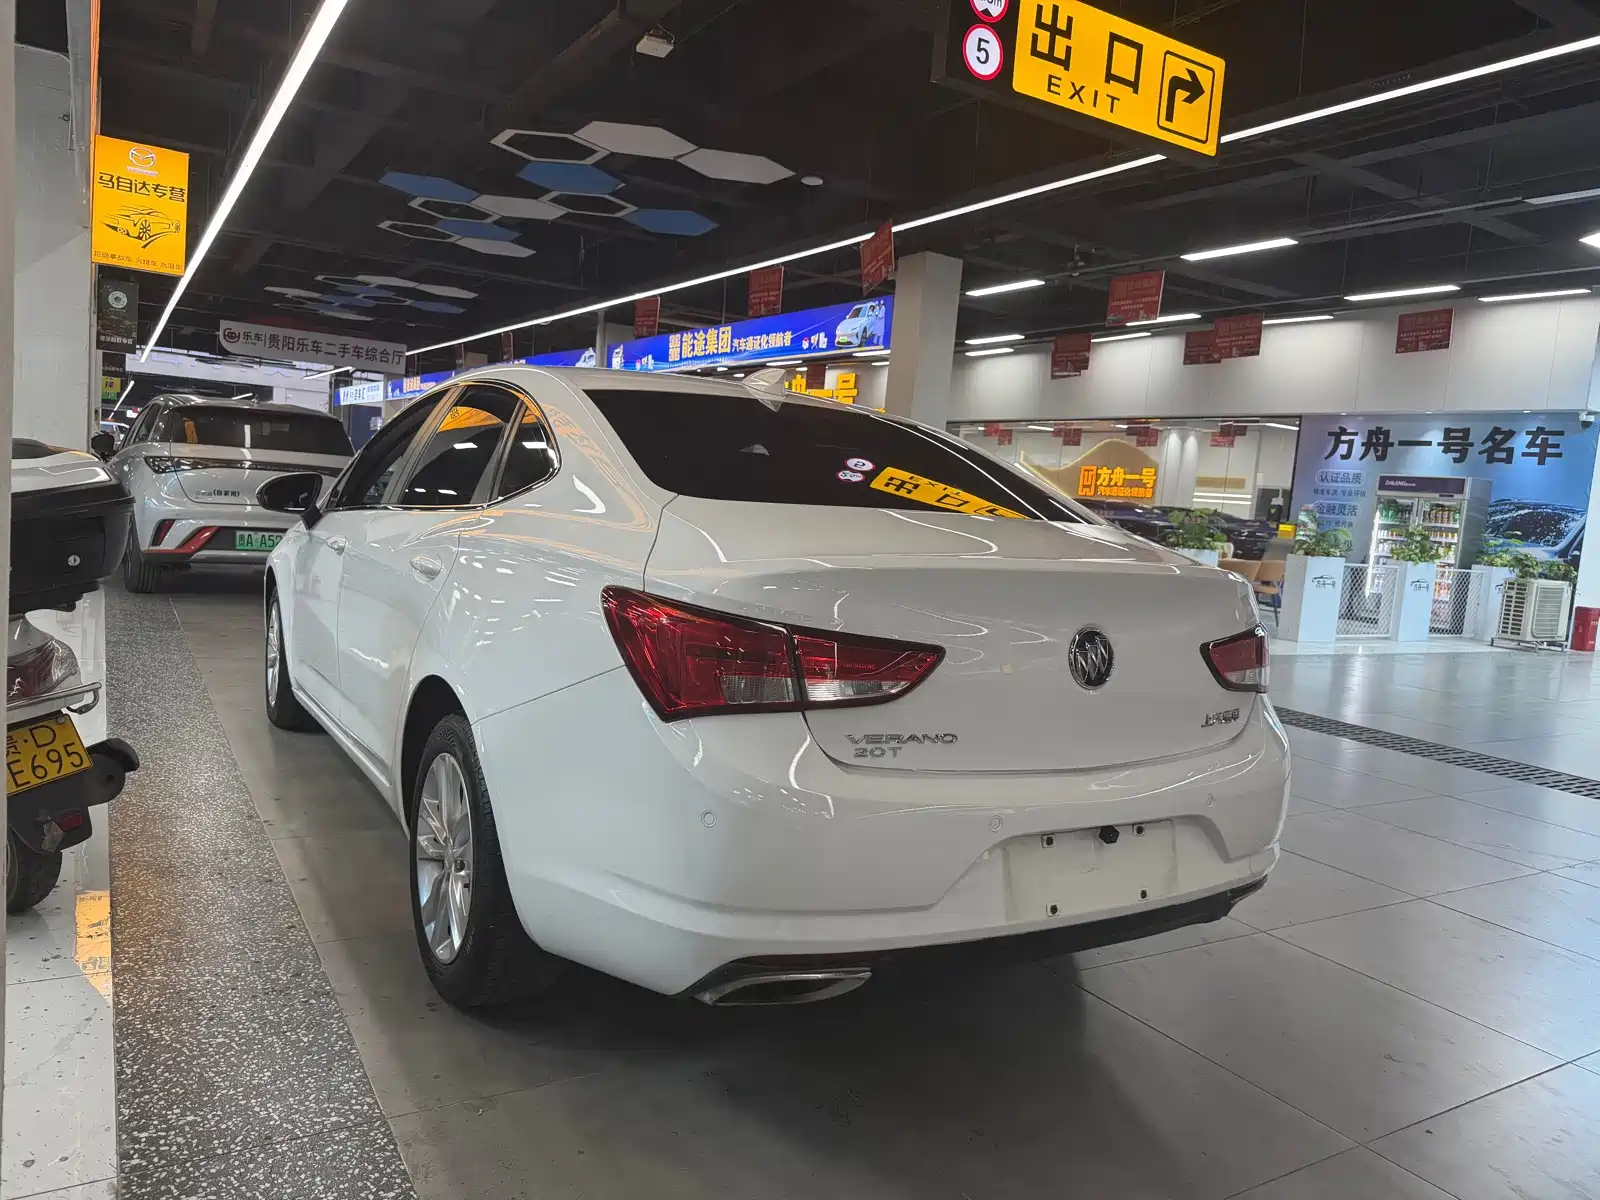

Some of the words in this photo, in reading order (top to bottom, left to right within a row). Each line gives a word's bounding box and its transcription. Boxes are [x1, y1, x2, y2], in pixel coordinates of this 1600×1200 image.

[975, 37, 990, 64] 5
[1030, 3, 1144, 95] 出口
[1047, 74, 1120, 114] EXIT
[98, 172, 185, 202] 马自达专营
[242, 331, 263, 342] 乐车
[268, 334, 404, 365] 贵阳乐车二手车综合厅
[682, 326, 731, 358] 能途集团
[1324, 426, 1565, 466] 方舟一号名车
[1096, 466, 1157, 488] 方舟一号
[1319, 471, 1362, 484] 认证品质
[844, 733, 959, 744] VERANO
[853, 746, 903, 758] 20T
[7, 742, 84, 788] E695
